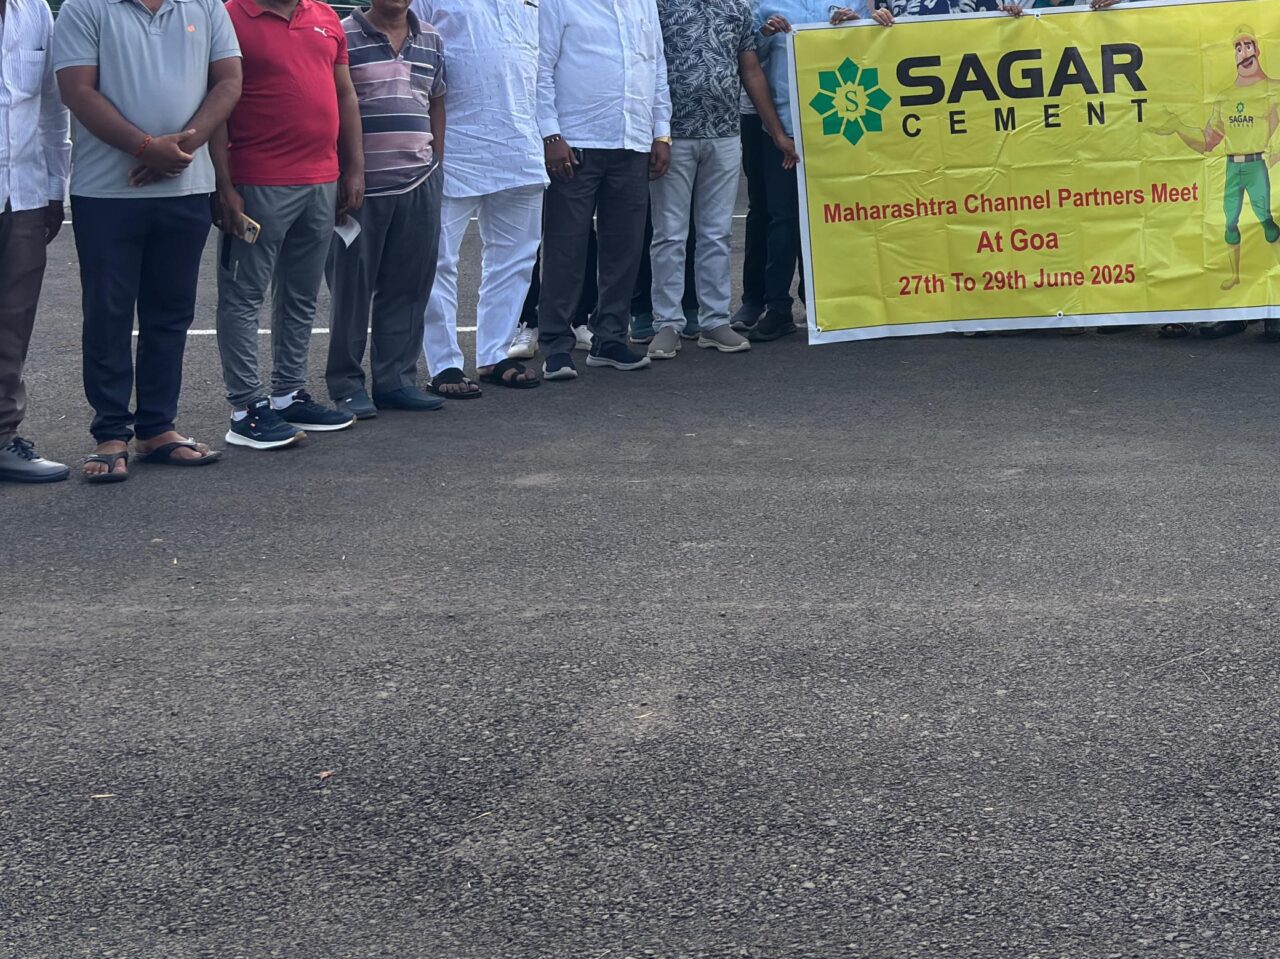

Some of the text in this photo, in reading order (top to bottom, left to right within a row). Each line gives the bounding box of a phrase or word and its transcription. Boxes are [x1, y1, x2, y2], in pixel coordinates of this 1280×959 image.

[896, 43, 1147, 106] SAGAR
[844, 90, 860, 113] S
[902, 99, 1147, 137] CEMENT
[1228, 115, 1254, 124] SAGAR
[824, 183, 1198, 223] Maharashtra Channel Partners Meet
[977, 229, 1058, 253] At Goa
[899, 264, 1135, 295] 27th To 29th June 2025
